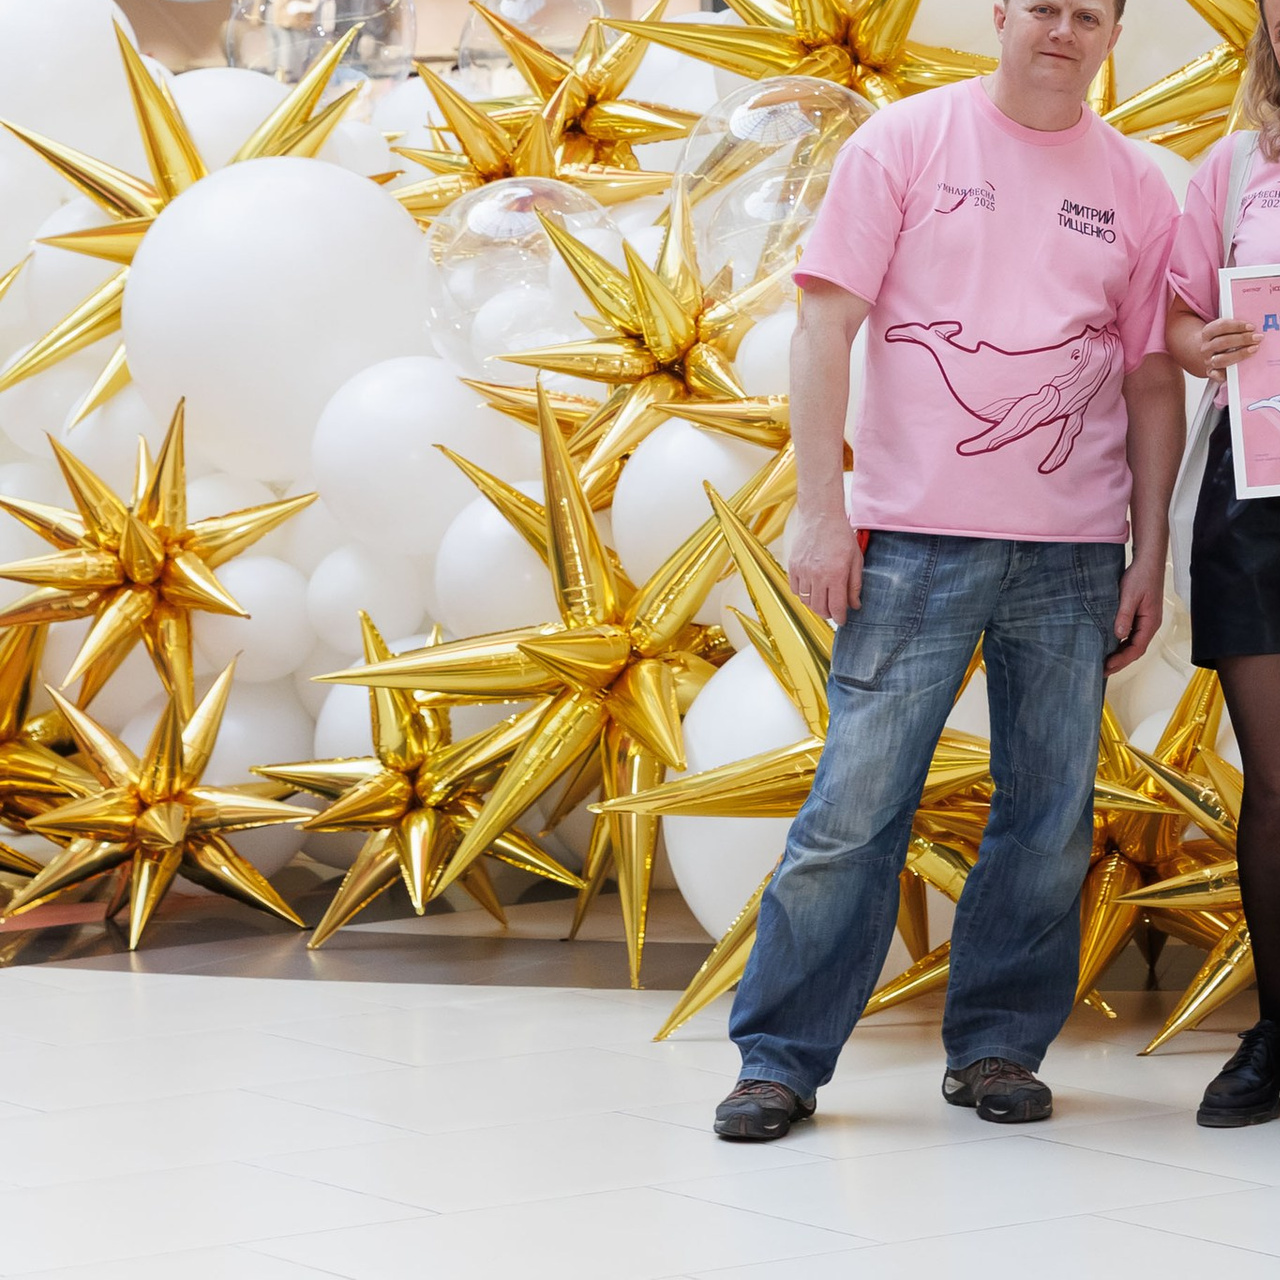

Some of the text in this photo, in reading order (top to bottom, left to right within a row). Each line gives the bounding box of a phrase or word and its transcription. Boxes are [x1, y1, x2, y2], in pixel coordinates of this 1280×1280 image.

[969, 187, 996, 202] ВЕСНА
[974, 196, 996, 212] 2025
[1061, 199, 1116, 225] ДМИТРИЙ
[1057, 212, 1117, 244] ТИЩЕНКО
